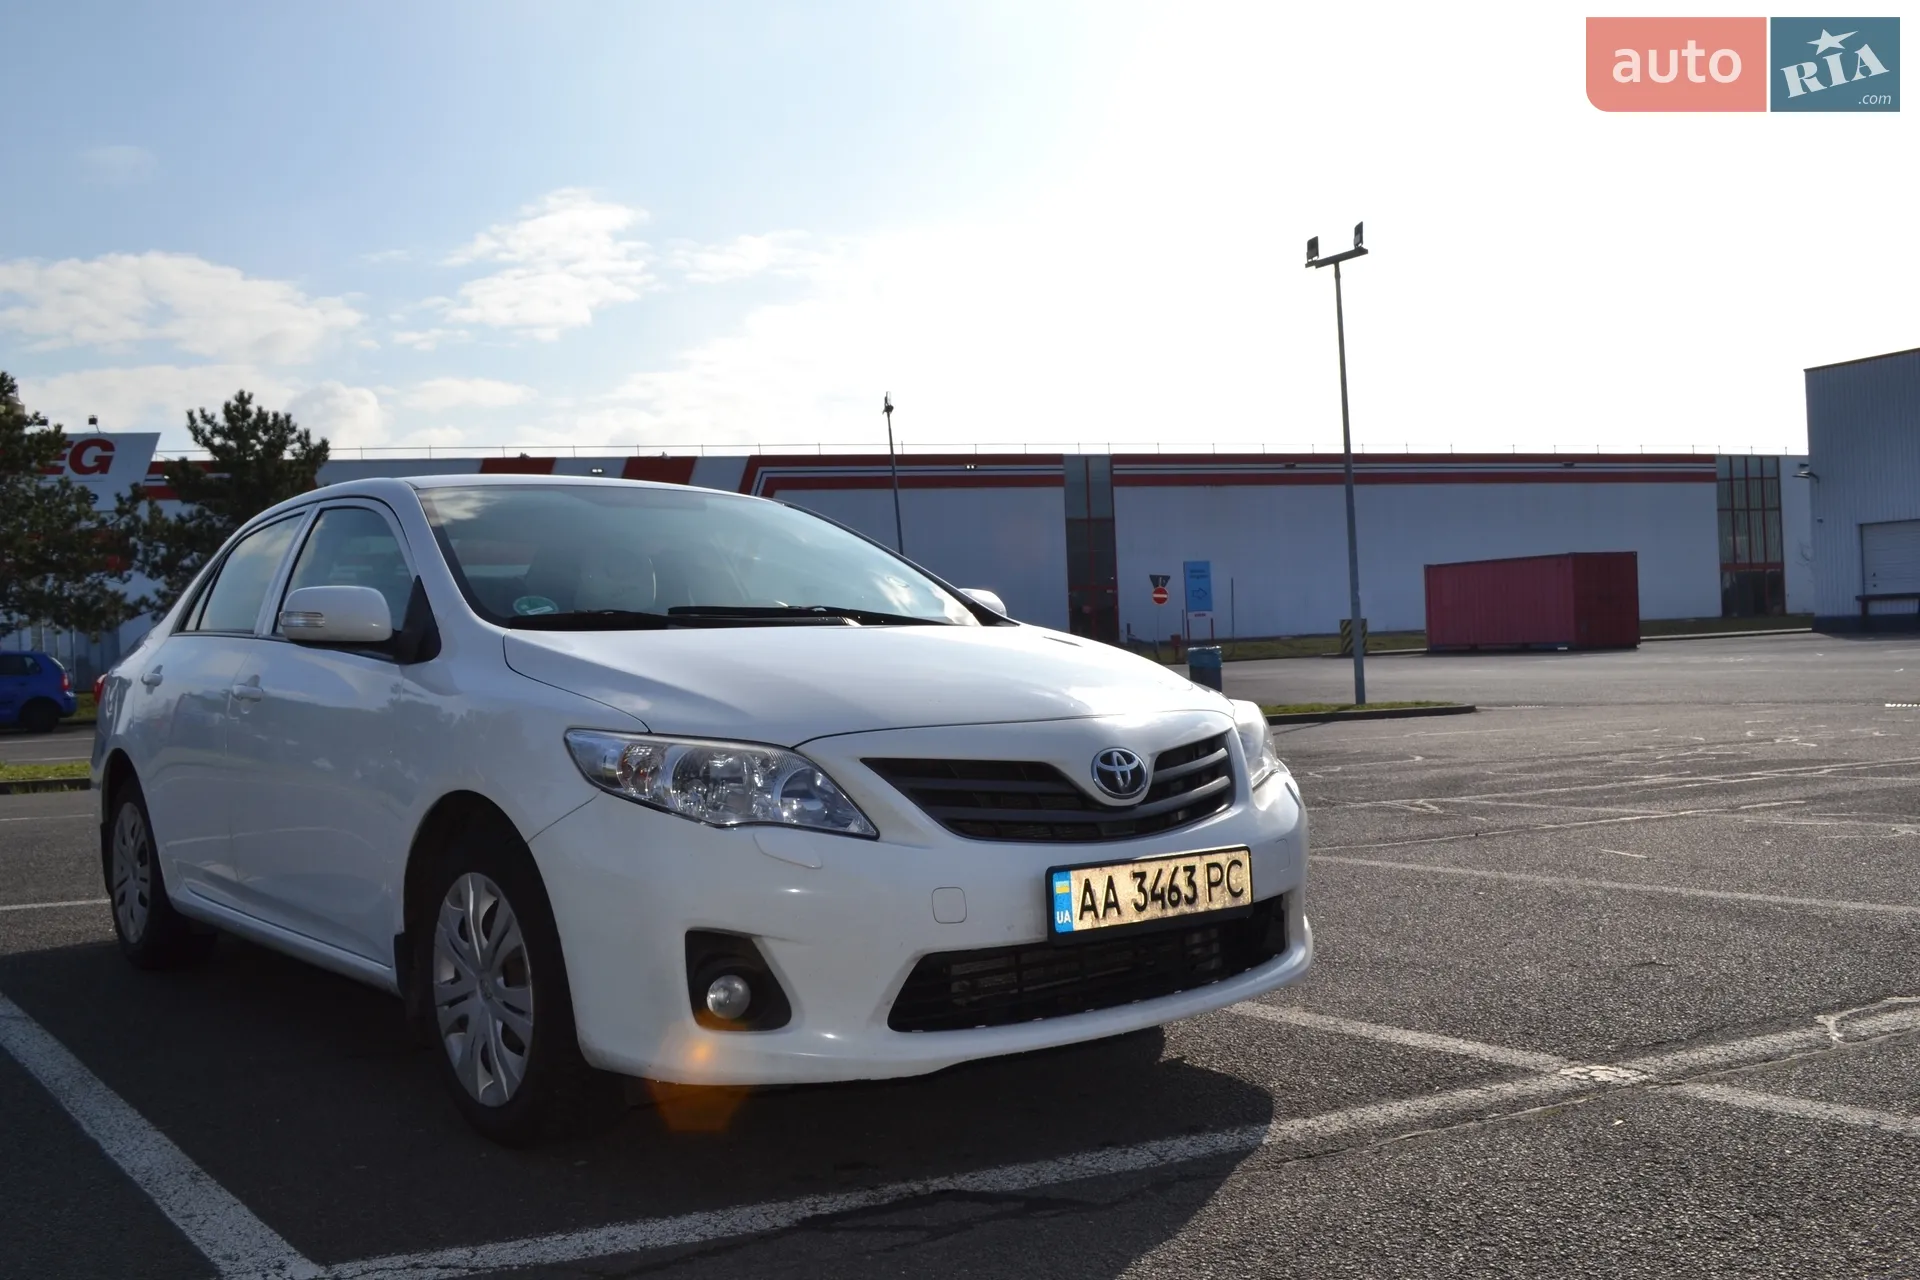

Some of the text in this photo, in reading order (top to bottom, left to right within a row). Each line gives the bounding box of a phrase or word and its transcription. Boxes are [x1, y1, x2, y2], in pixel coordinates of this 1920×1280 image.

[37, 438, 115, 475] EG
[1078, 859, 1244, 920] AA 3463 PC
[1056, 911, 1071, 924] UA
